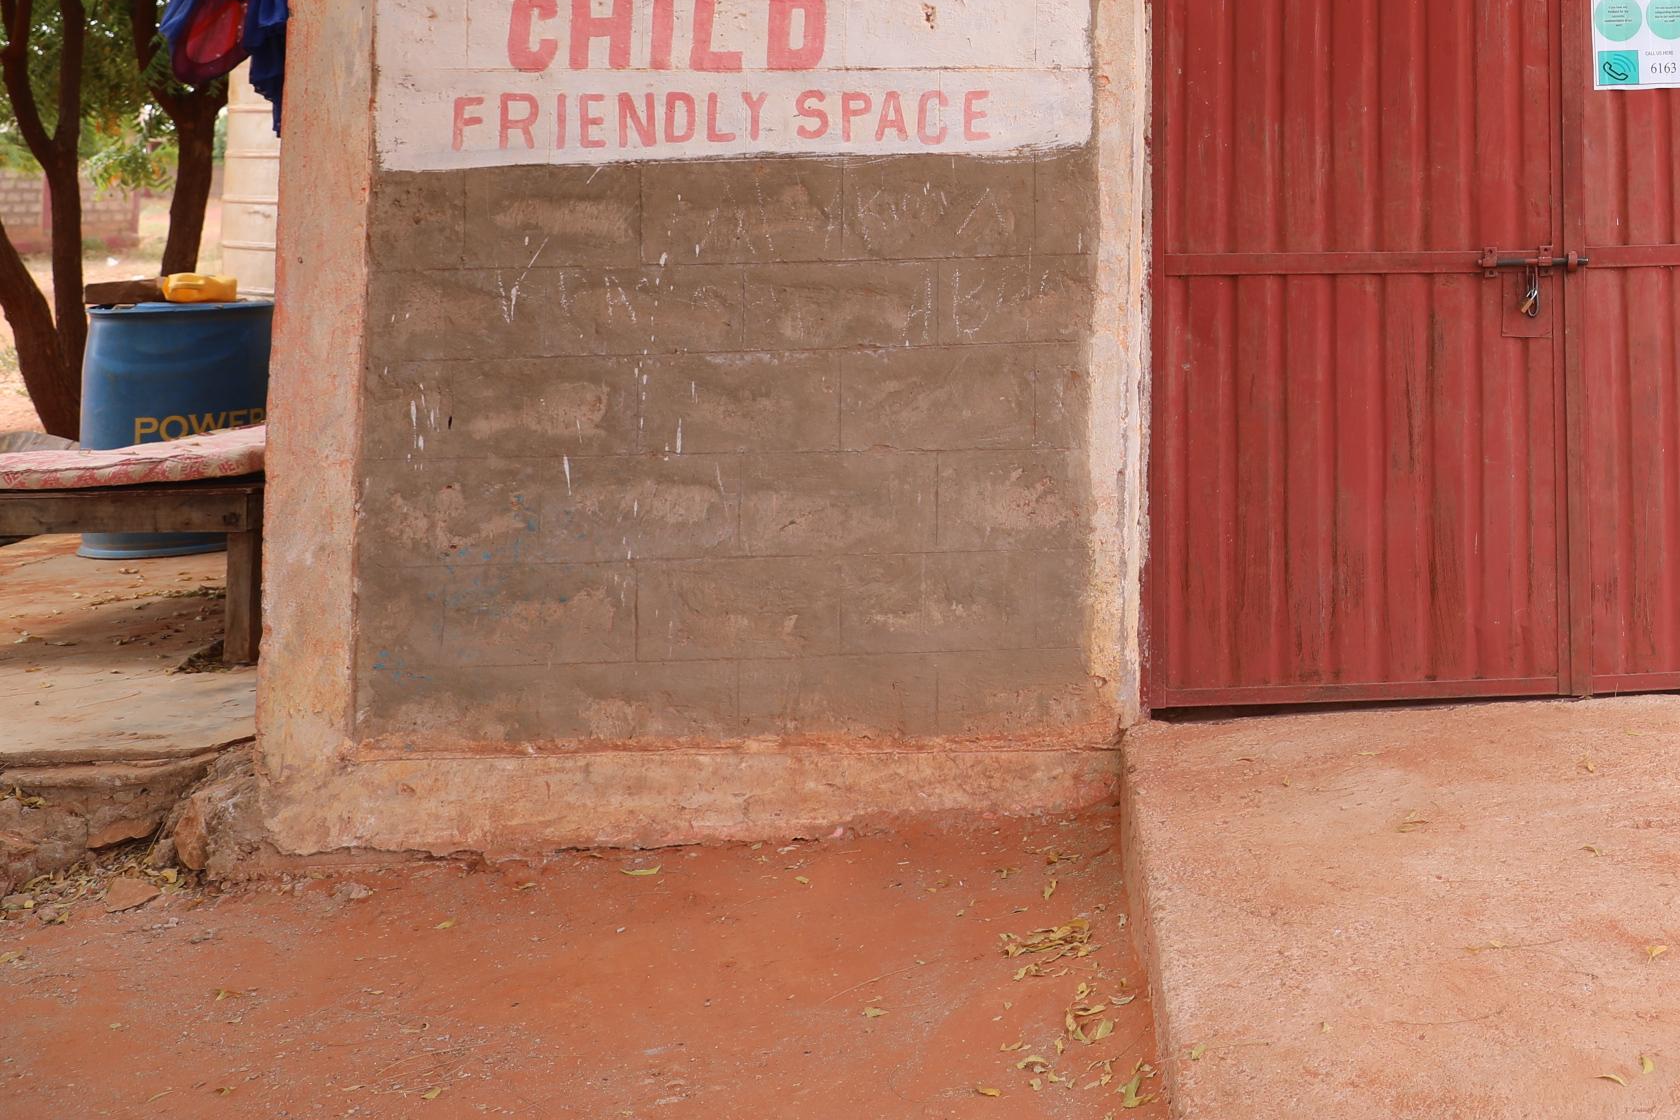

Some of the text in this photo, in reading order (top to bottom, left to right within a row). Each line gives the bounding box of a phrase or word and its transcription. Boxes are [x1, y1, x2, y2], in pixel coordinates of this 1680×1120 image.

[1650, 62, 1677, 74] 6163
[451, 88, 992, 152] FRIENDLY SPACE
